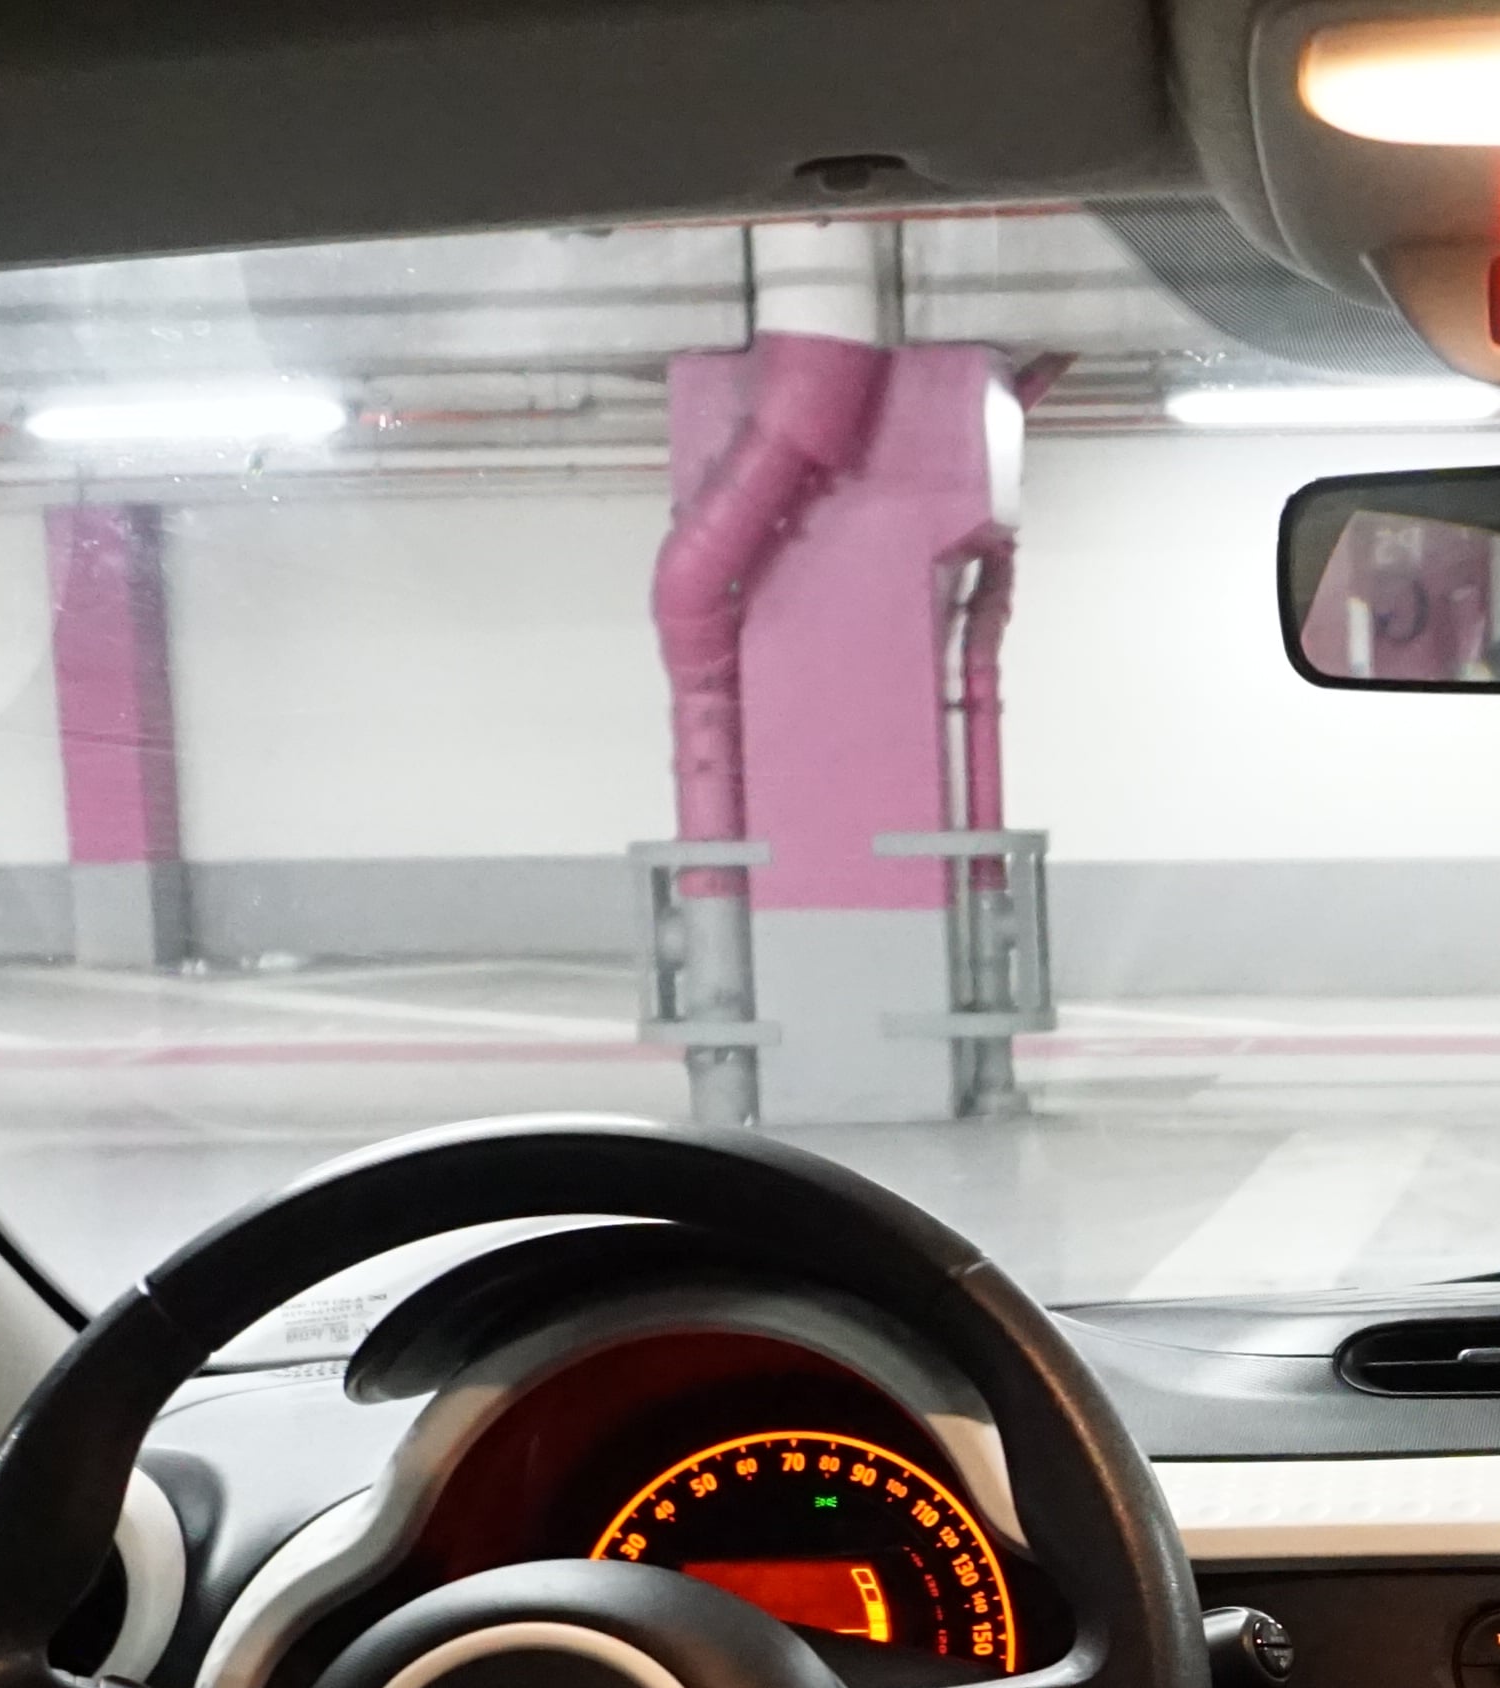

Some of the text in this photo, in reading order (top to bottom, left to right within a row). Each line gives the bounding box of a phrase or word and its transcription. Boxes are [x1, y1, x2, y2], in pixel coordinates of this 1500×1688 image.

[736, 1458, 758, 1476] 60
[781, 1453, 806, 1472] 70
[819, 1455, 840, 1472] 80
[689, 1472, 718, 1497] 50
[851, 1463, 878, 1487] 90
[886, 1478, 908, 1498] 100
[654, 1499, 676, 1519] 40
[910, 1499, 940, 1528] 110
[621, 1533, 647, 1561] 30
[939, 1526, 960, 1548] 120
[952, 1553, 980, 1587] 130
[971, 1591, 989, 1613] 140
[972, 1622, 994, 1656] 150
